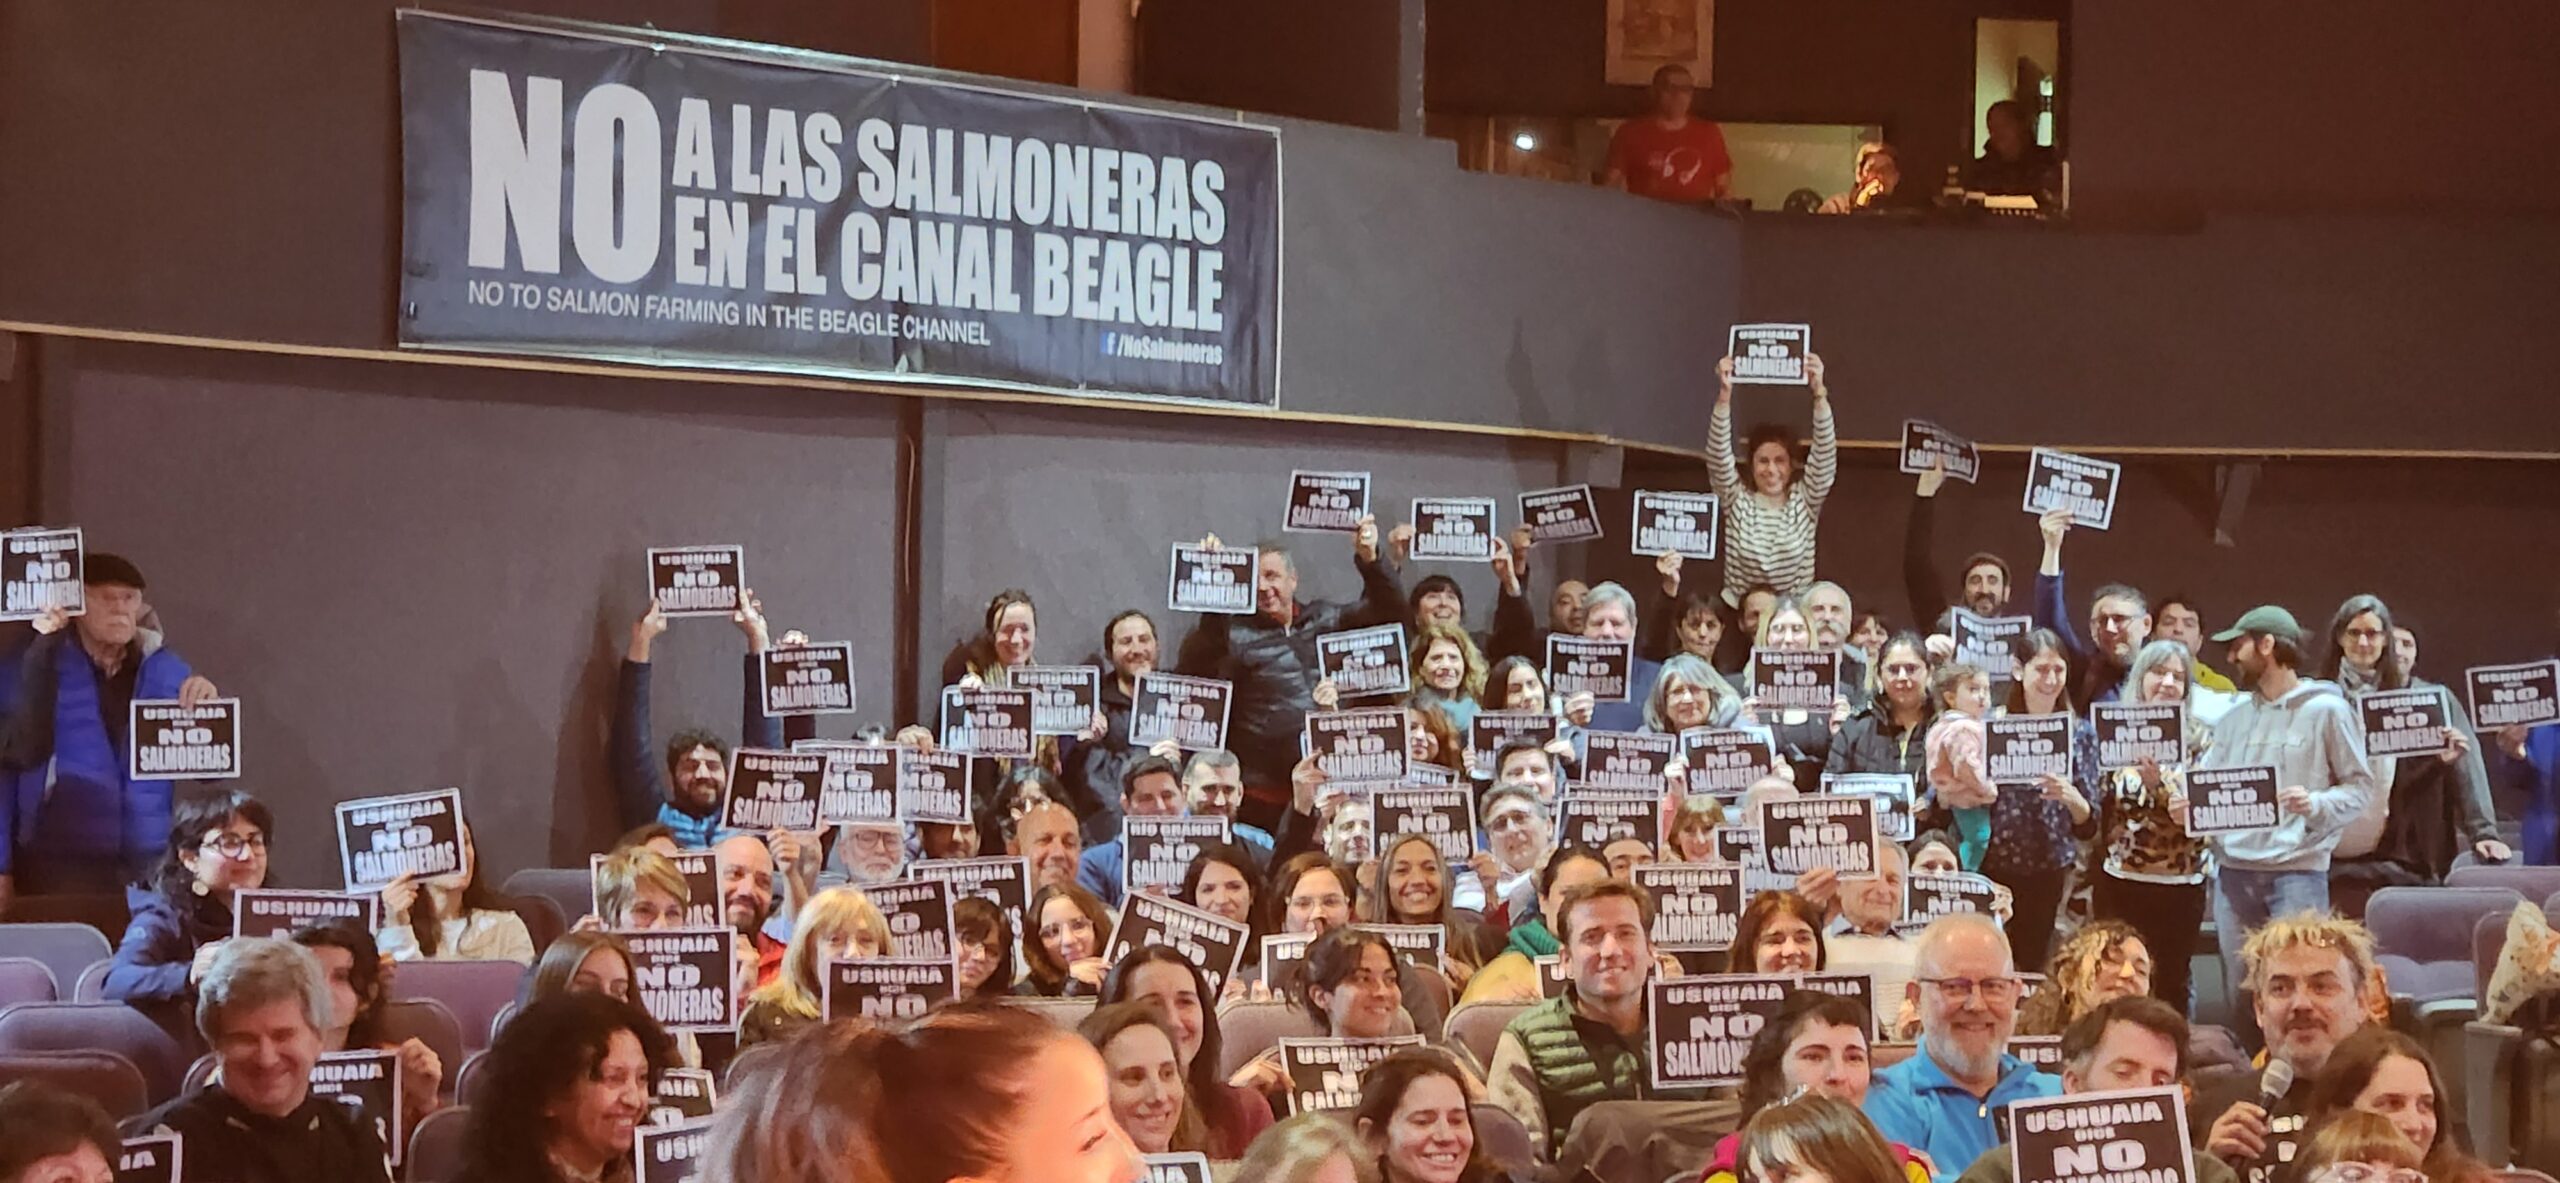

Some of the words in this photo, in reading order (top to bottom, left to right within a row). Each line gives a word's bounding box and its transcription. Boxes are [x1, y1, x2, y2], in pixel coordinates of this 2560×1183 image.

[468, 68, 662, 284] NO
[673, 97, 717, 190] A
[732, 103, 842, 203] LAS
[857, 118, 1224, 245] SALMONERAS
[675, 195, 750, 289] EN
[765, 204, 828, 297] EL
[841, 211, 1021, 313] CANAL
[1033, 231, 1223, 332] BEAGLE
[468, 281, 502, 307] NO
[509, 284, 541, 310] TO
[546, 287, 640, 319] SALMON
[645, 294, 739, 326] FARMING
[746, 301, 766, 328] IN
[774, 304, 813, 333] THE
[819, 308, 900, 338] BEAGLE
[902, 317, 991, 347] CHANNEL
[1746, 344, 1788, 358] NO
[2051, 476, 2093, 497] NO
[1308, 494, 1350, 510] NO
[1536, 508, 1575, 524] NO
[1655, 514, 1696, 531] NO
[1432, 518, 1476, 535] NO
[26, 561, 71, 582] NO
[674, 570, 721, 588] NO
[1191, 567, 1235, 585] NO
[1343, 650, 1386, 671] NO
[1567, 661, 1609, 677] NO
[786, 667, 833, 685] NO
[1773, 670, 1818, 685] NO
[2493, 686, 2539, 703] NO
[1155, 699, 1205, 720] NO
[965, 710, 1022, 729] NO
[2383, 712, 2429, 731] NO
[158, 727, 212, 746] NO
[2115, 726, 2162, 742] NO
[1334, 736, 1384, 755] NO
[2006, 739, 2054, 755] NO
[140, 744, 231, 772] SALMONERAS
[1606, 756, 1652, 774] NO
[1705, 751, 1753, 768] NO
[756, 778, 805, 801] NO
[2208, 788, 2258, 805] NO
[371, 825, 433, 853] NO
[1789, 826, 1849, 846] NO
[252, 900, 361, 917] USHUAIA
[1662, 893, 1719, 915] NO
[635, 964, 702, 990] NO
[842, 966, 945, 984] USHUAIA
[1666, 983, 1784, 1005] USHUAIA
[862, 996, 928, 1018] NO
[1690, 1014, 1764, 1040] NO
[2025, 1101, 2164, 1133] USHUAIA
[2053, 1139, 2147, 1178] NO
